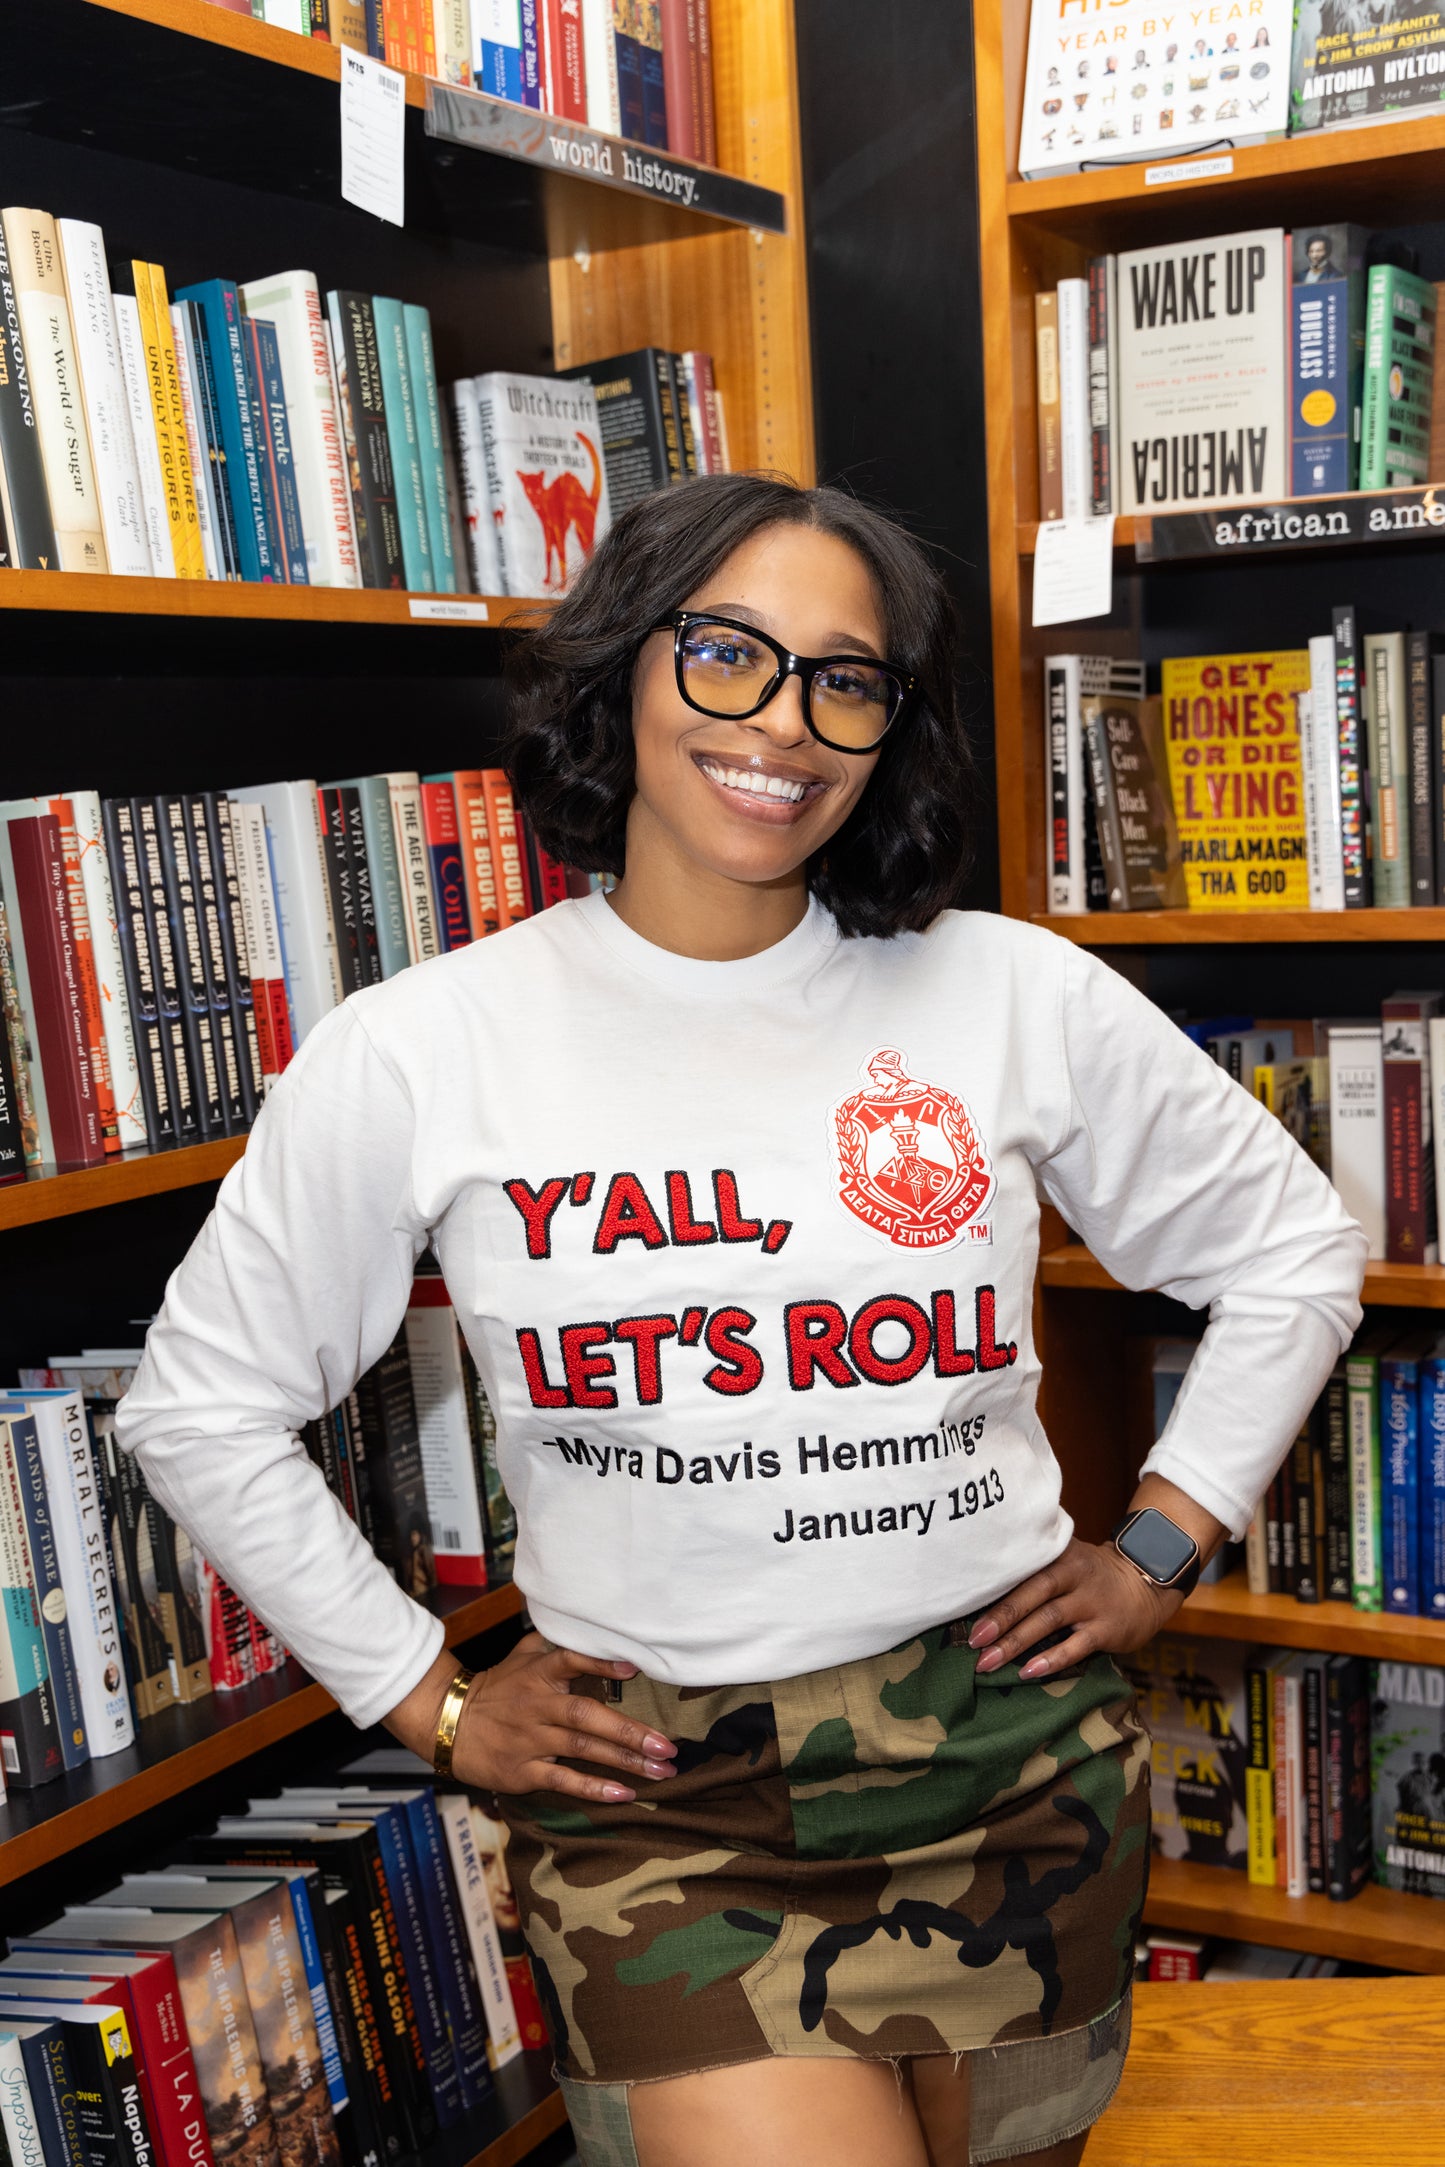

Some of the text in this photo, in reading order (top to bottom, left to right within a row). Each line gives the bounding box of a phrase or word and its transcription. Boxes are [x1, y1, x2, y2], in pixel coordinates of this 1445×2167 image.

[1058, 3, 1264, 53] YEAR BY YEAR
[1316, 13, 1440, 49] RACE and INSANITY
[1331, 48, 1352, 63] JIM
[1355, 39, 1394, 56] CROW
[1303, 65, 1375, 100] ANTONIA
[549, 136, 699, 205] world history.
[1149, 161, 1228, 181] WORLD HISTORY
[32, 230, 44, 278] Bosma
[43, 240, 52, 272] Ulbe
[83, 272, 100, 333] SPRING
[224, 292, 236, 322] Eco
[1130, 252, 1216, 330] WAKE
[1226, 245, 1266, 316] UP
[229, 326, 241, 350] THE
[1300, 300, 1323, 380] DOUGLASS
[1369, 275, 1386, 369] I'M STILL HERE
[2, 278, 34, 428] RECKONING
[231, 353, 247, 396] SEARCH
[348, 301, 373, 411] of PREHISTORY
[364, 320, 383, 412] INVENTION
[50, 317, 85, 497] The World of Sugar
[238, 401, 250, 423] FOR
[270, 380, 280, 397] The
[507, 385, 594, 422] Witchcraft
[148, 345, 181, 523] UNRULY FIGURES
[164, 349, 197, 524] UNRULY FIGURES
[241, 427, 253, 449] THE
[268, 402, 290, 465] Horde
[305, 290, 354, 566] HOMELANDS TIMOTHY GARTON ASH
[537, 435, 567, 448] HISTORY
[244, 451, 261, 503] PERFECT
[523, 451, 558, 467] THIRTEEN
[1132, 426, 1268, 504] AMERICA
[252, 506, 271, 567] LANGUAGE
[1215, 508, 1350, 546] african
[1200, 663, 1274, 689] GET
[1050, 682, 1067, 775] THE GRIFT
[1107, 716, 1134, 743] Self-
[1182, 743, 1297, 767] OR DIE
[1111, 746, 1139, 771] Care
[403, 801, 416, 828] THE
[1117, 790, 1149, 812] Black
[1185, 771, 1297, 821] LYING
[58, 824, 78, 866] THE
[408, 831, 422, 865] AGE
[495, 793, 524, 909] THE BOOK
[1121, 817, 1147, 842] Men
[1180, 838, 1306, 863] HARLAMAGN
[349, 806, 375, 927] WHY WAR?
[414, 869, 426, 890] OF
[1200, 869, 1287, 895] THA GOD
[67, 869, 91, 942] PICNIC
[50, 861, 92, 1100] Fifty Ships that Changed the Course of History
[116, 805, 168, 1114] THE FUTURE OF GEOGRAPHY TIM MARSHALL
[140, 805, 191, 1110] THE FUTURE OF GEOGRAPHY TIM MARSHALL
[10, 1020, 33, 1121] Jonathan Kennedy
[90, 1046, 104, 1083] LONGO
[502, 1168, 793, 1260] Y'ALL,
[968, 1224, 987, 1240] TM
[516, 1284, 1019, 1411] LET'S ROLL.
[656, 1440, 781, 1487] Davis
[798, 1412, 988, 1475] Hemmings
[2, 1440, 29, 1565] THE RACE TO THE
[23, 1434, 58, 1583] HANDS of TIME
[773, 1466, 1006, 1544] January 1913
[1353, 1400, 1369, 1577] DRIVING THE GREEN BOOK
[64, 1404, 95, 1520] MORTAL
[86, 1536, 118, 1656] SECRETS
[30, 1644, 51, 1726] KASSIA ST. CLAIR
[55, 1628, 79, 1722] REBECCA STRUTHERS
[1183, 1698, 1235, 1737] MY
[1152, 1742, 1221, 1786] ECK
[456, 1817, 481, 1891] FRANCE
[369, 1908, 406, 2036] LYNNE OLSON
[155, 2000, 170, 2044] McShea
[164, 1992, 180, 2042] Bronwen
[268, 1914, 313, 2090] THE NAPOLEONIC WARS
[345, 1924, 392, 2102] EMPRESS OF THE NILE
[209, 1947, 257, 2127] THE NAPOLEONIC WARS
[173, 2071, 193, 2112] LA
